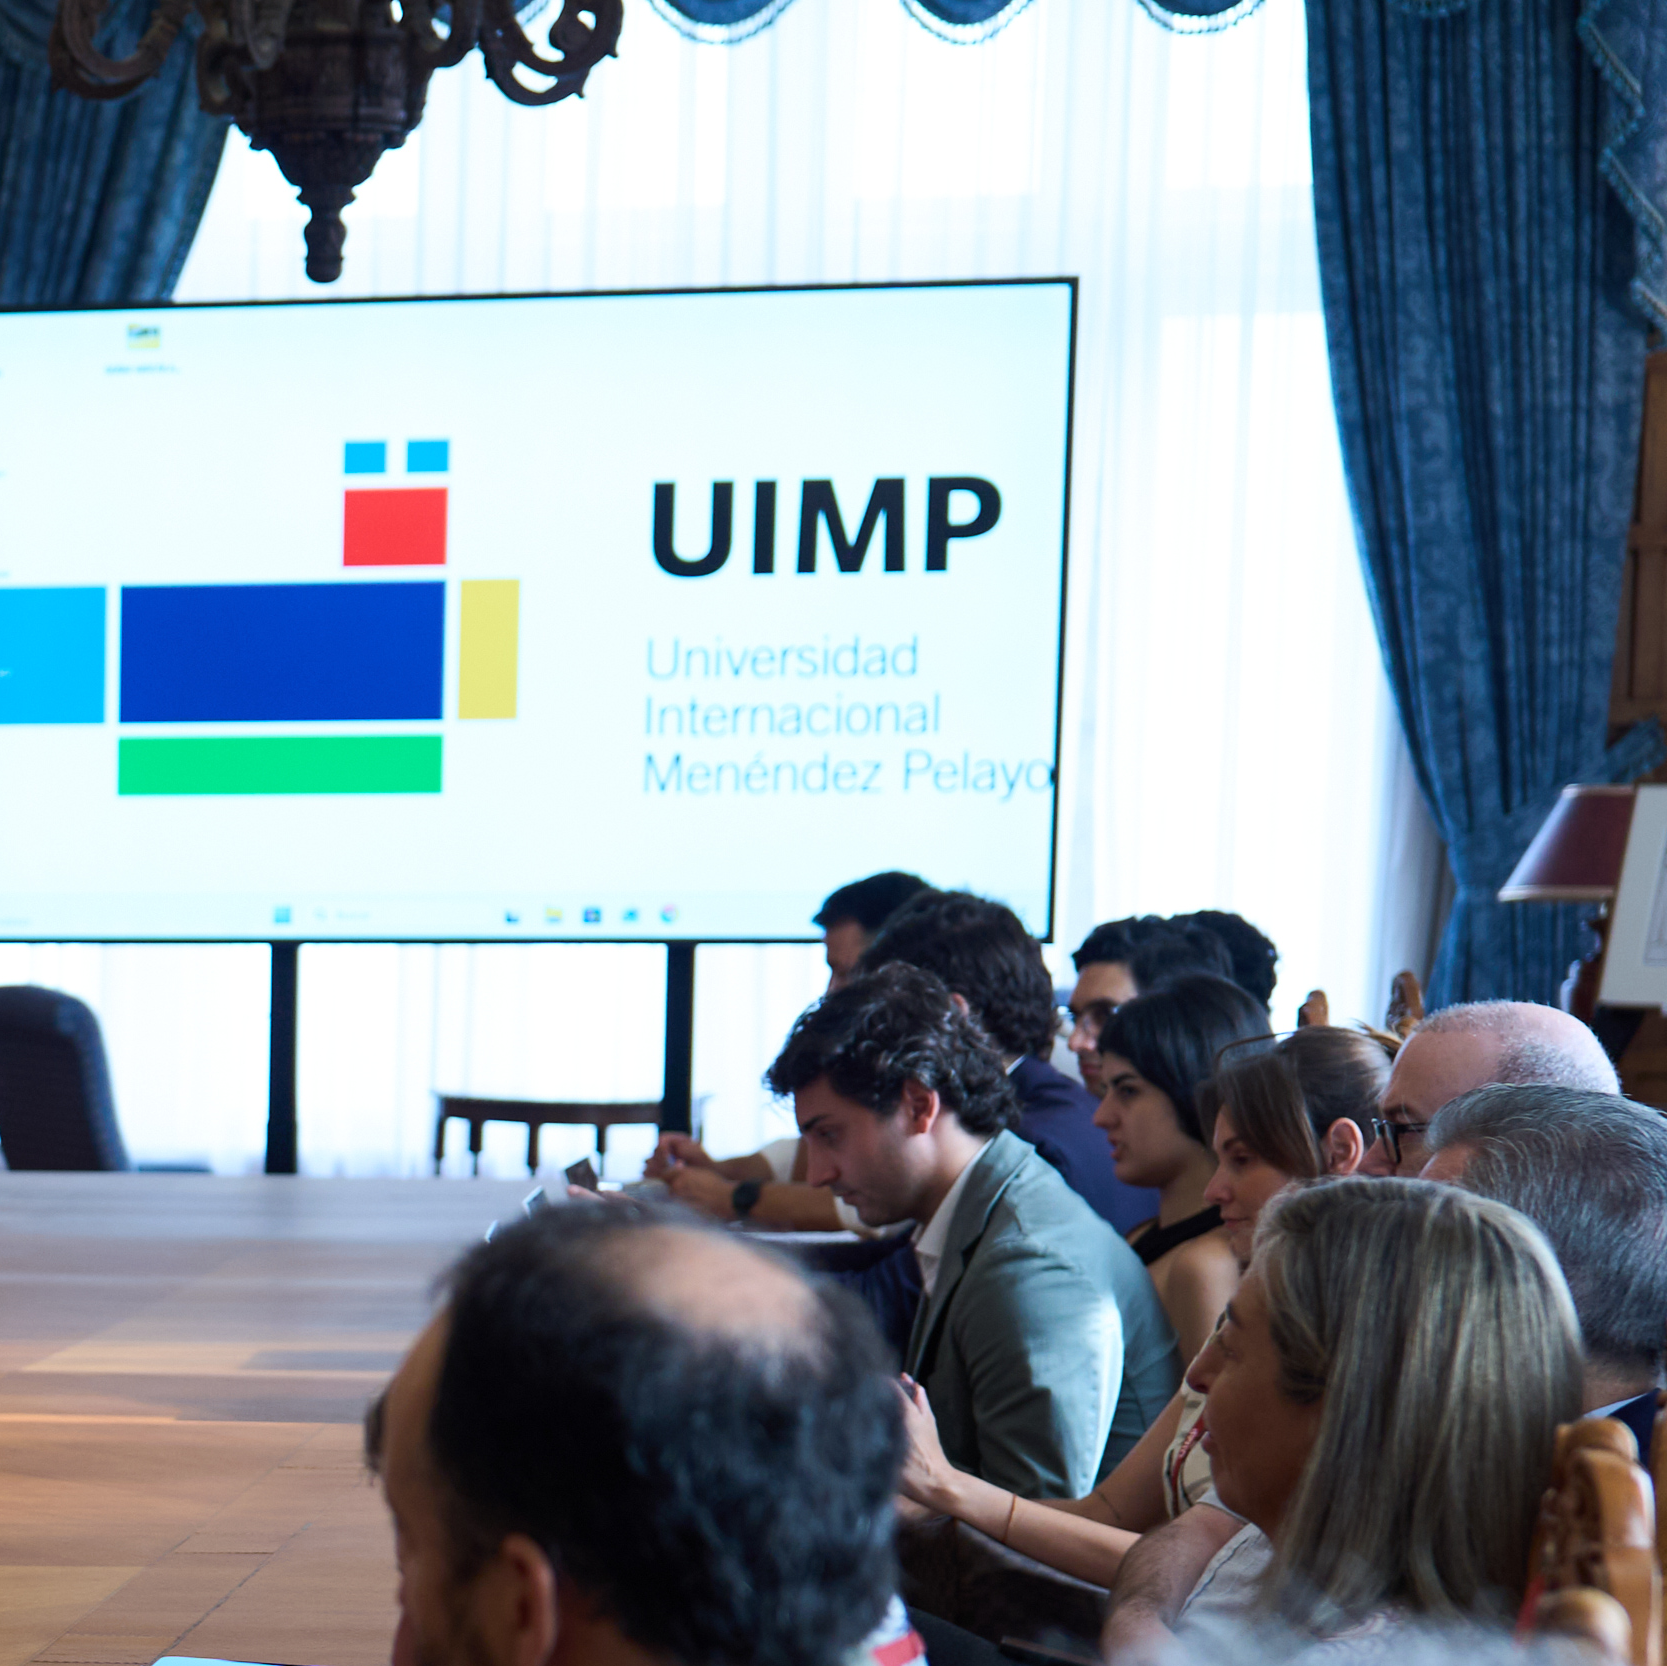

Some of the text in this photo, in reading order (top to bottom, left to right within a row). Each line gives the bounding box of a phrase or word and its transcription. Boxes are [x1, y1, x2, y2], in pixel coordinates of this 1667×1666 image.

[652, 475, 1003, 578] UIMP
[647, 634, 919, 682] Universidad
[643, 692, 941, 737] Internacional
[641, 748, 1054, 804] Menéndez Pelayo
